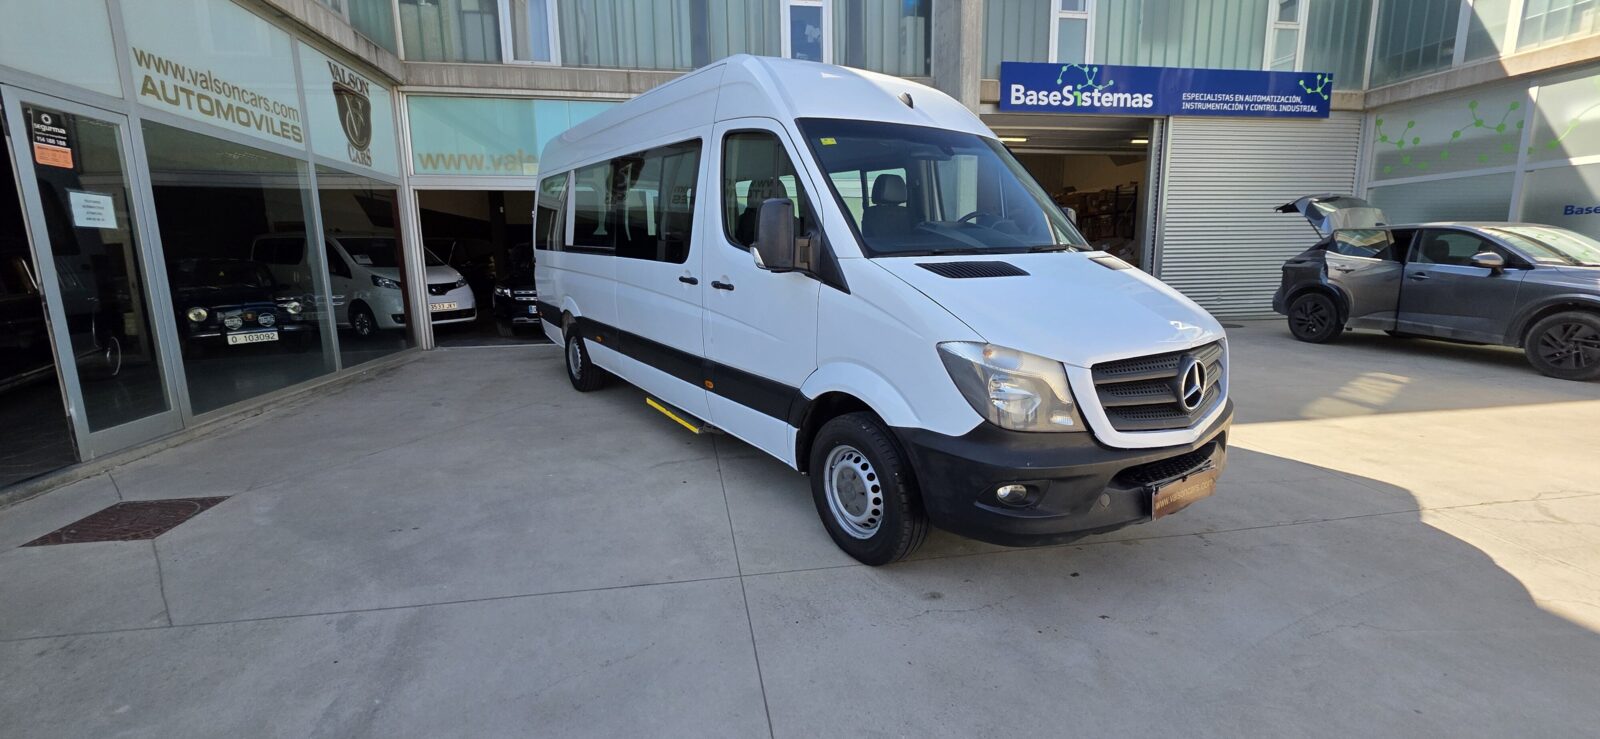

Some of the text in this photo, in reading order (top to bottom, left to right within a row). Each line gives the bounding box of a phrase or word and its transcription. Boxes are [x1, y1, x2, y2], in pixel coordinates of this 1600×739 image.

[132, 46, 299, 122] www.valsoncars.com
[327, 60, 370, 97] VALSON
[1010, 84, 1154, 108] BaseSistemas
[1182, 93, 1302, 104] ESPECIALISTAS EN AUTOMATIZACIÓN,
[140, 75, 303, 143] AUTOMOVILES
[1182, 102, 1318, 113] INSTRUMENTACIÓN Y CONTROL INDUSTRIAL
[33, 122, 66, 135] segurma
[347, 142, 372, 167] CARS
[1563, 205, 1600, 216] Base
[244, 332, 275, 342] 103092
